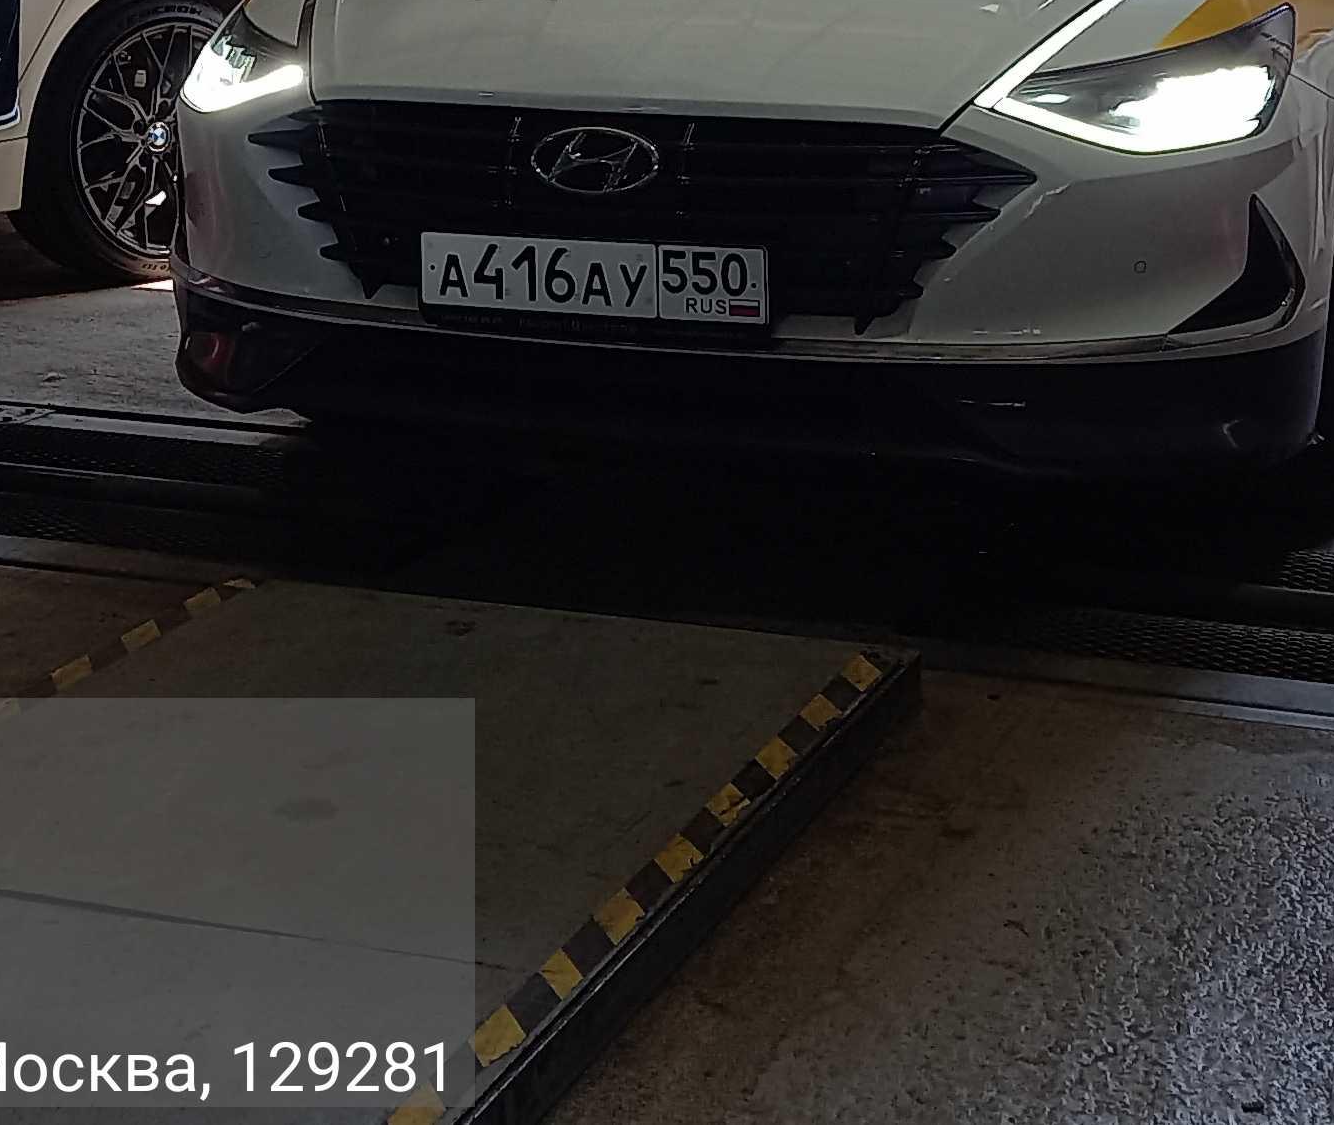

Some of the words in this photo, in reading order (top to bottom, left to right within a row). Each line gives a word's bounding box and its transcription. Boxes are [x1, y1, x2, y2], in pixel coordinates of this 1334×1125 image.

[439, 243, 648, 307] А416АУ
[662, 250, 749, 296] 550
[684, 297, 728, 315] RUS
